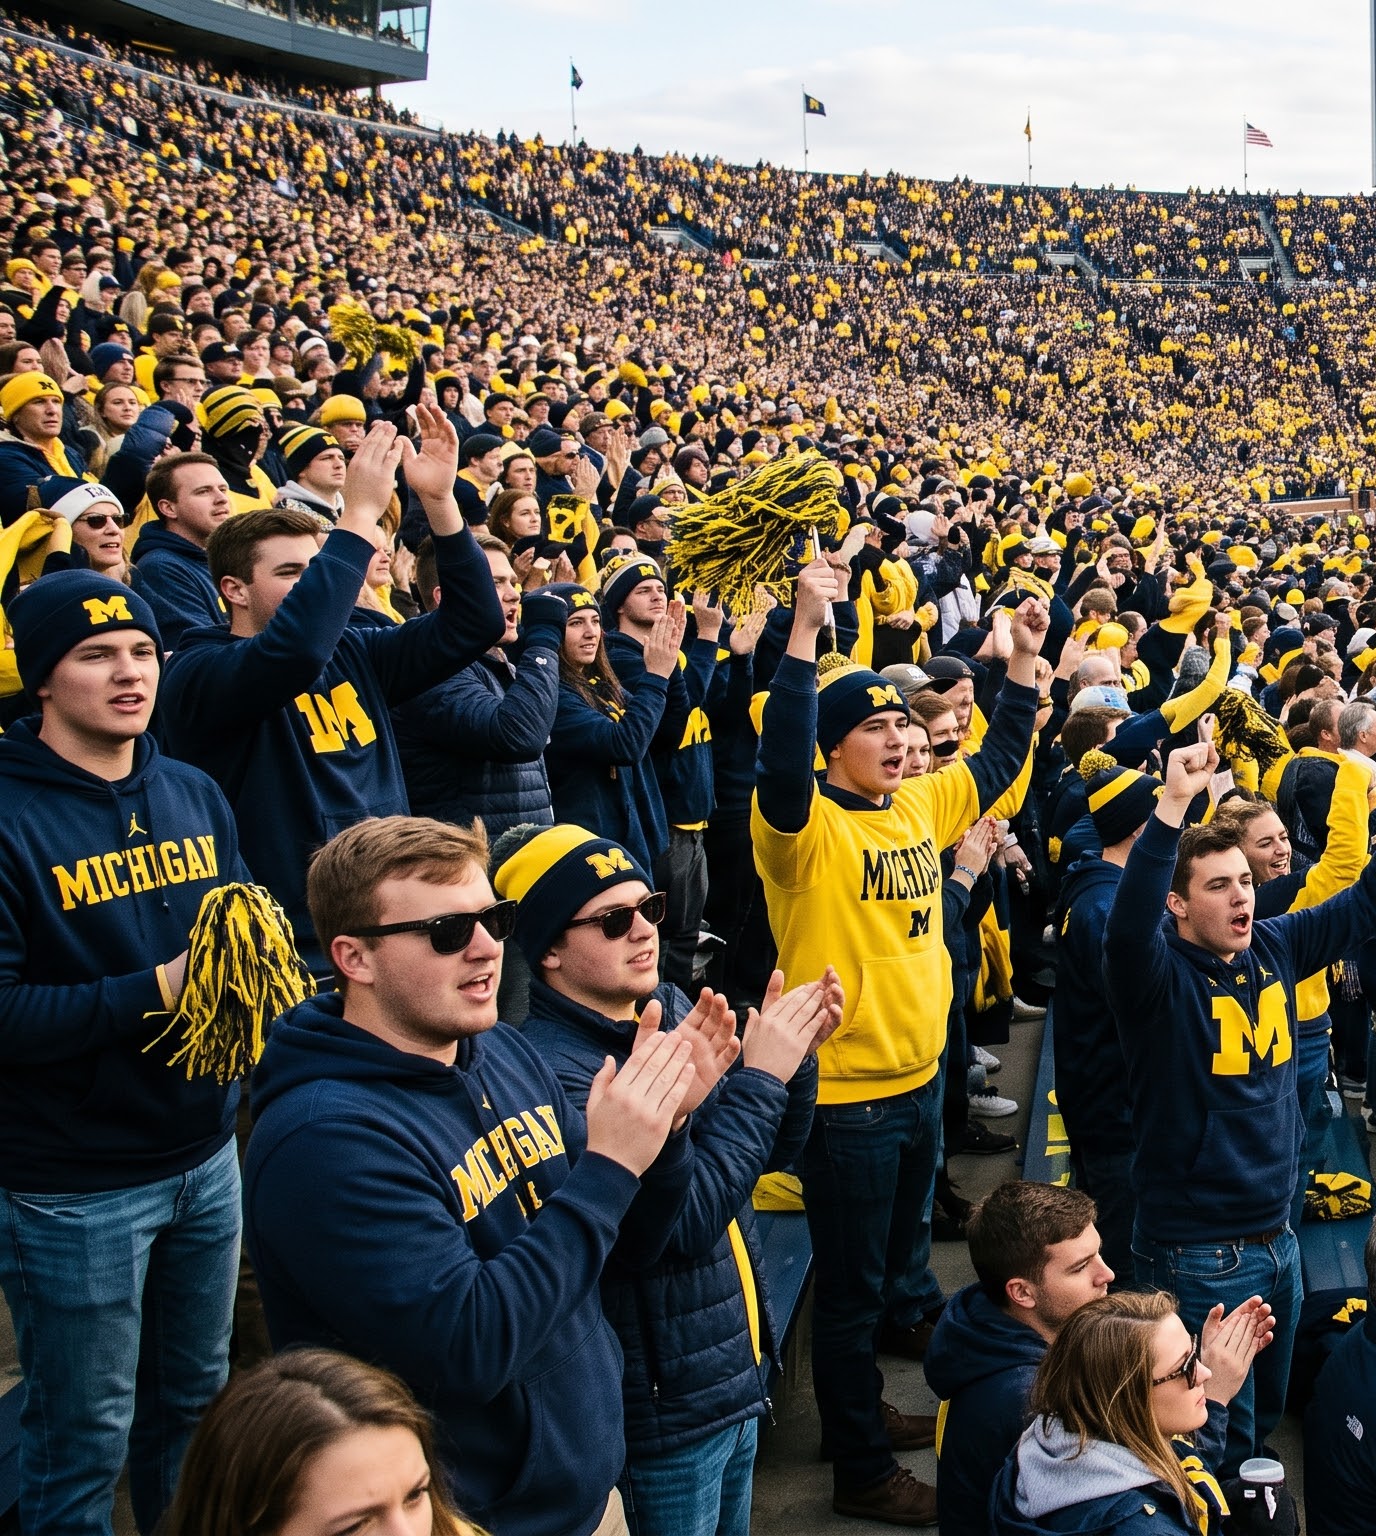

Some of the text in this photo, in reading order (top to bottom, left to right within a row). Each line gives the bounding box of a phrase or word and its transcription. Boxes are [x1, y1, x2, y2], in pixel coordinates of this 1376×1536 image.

[82, 595, 134, 625] M
[866, 684, 904, 708] M
[51, 835, 219, 911] MICHIGAN
[585, 847, 634, 880] M
[908, 906, 932, 939] M
[1211, 980, 1293, 1076] M
